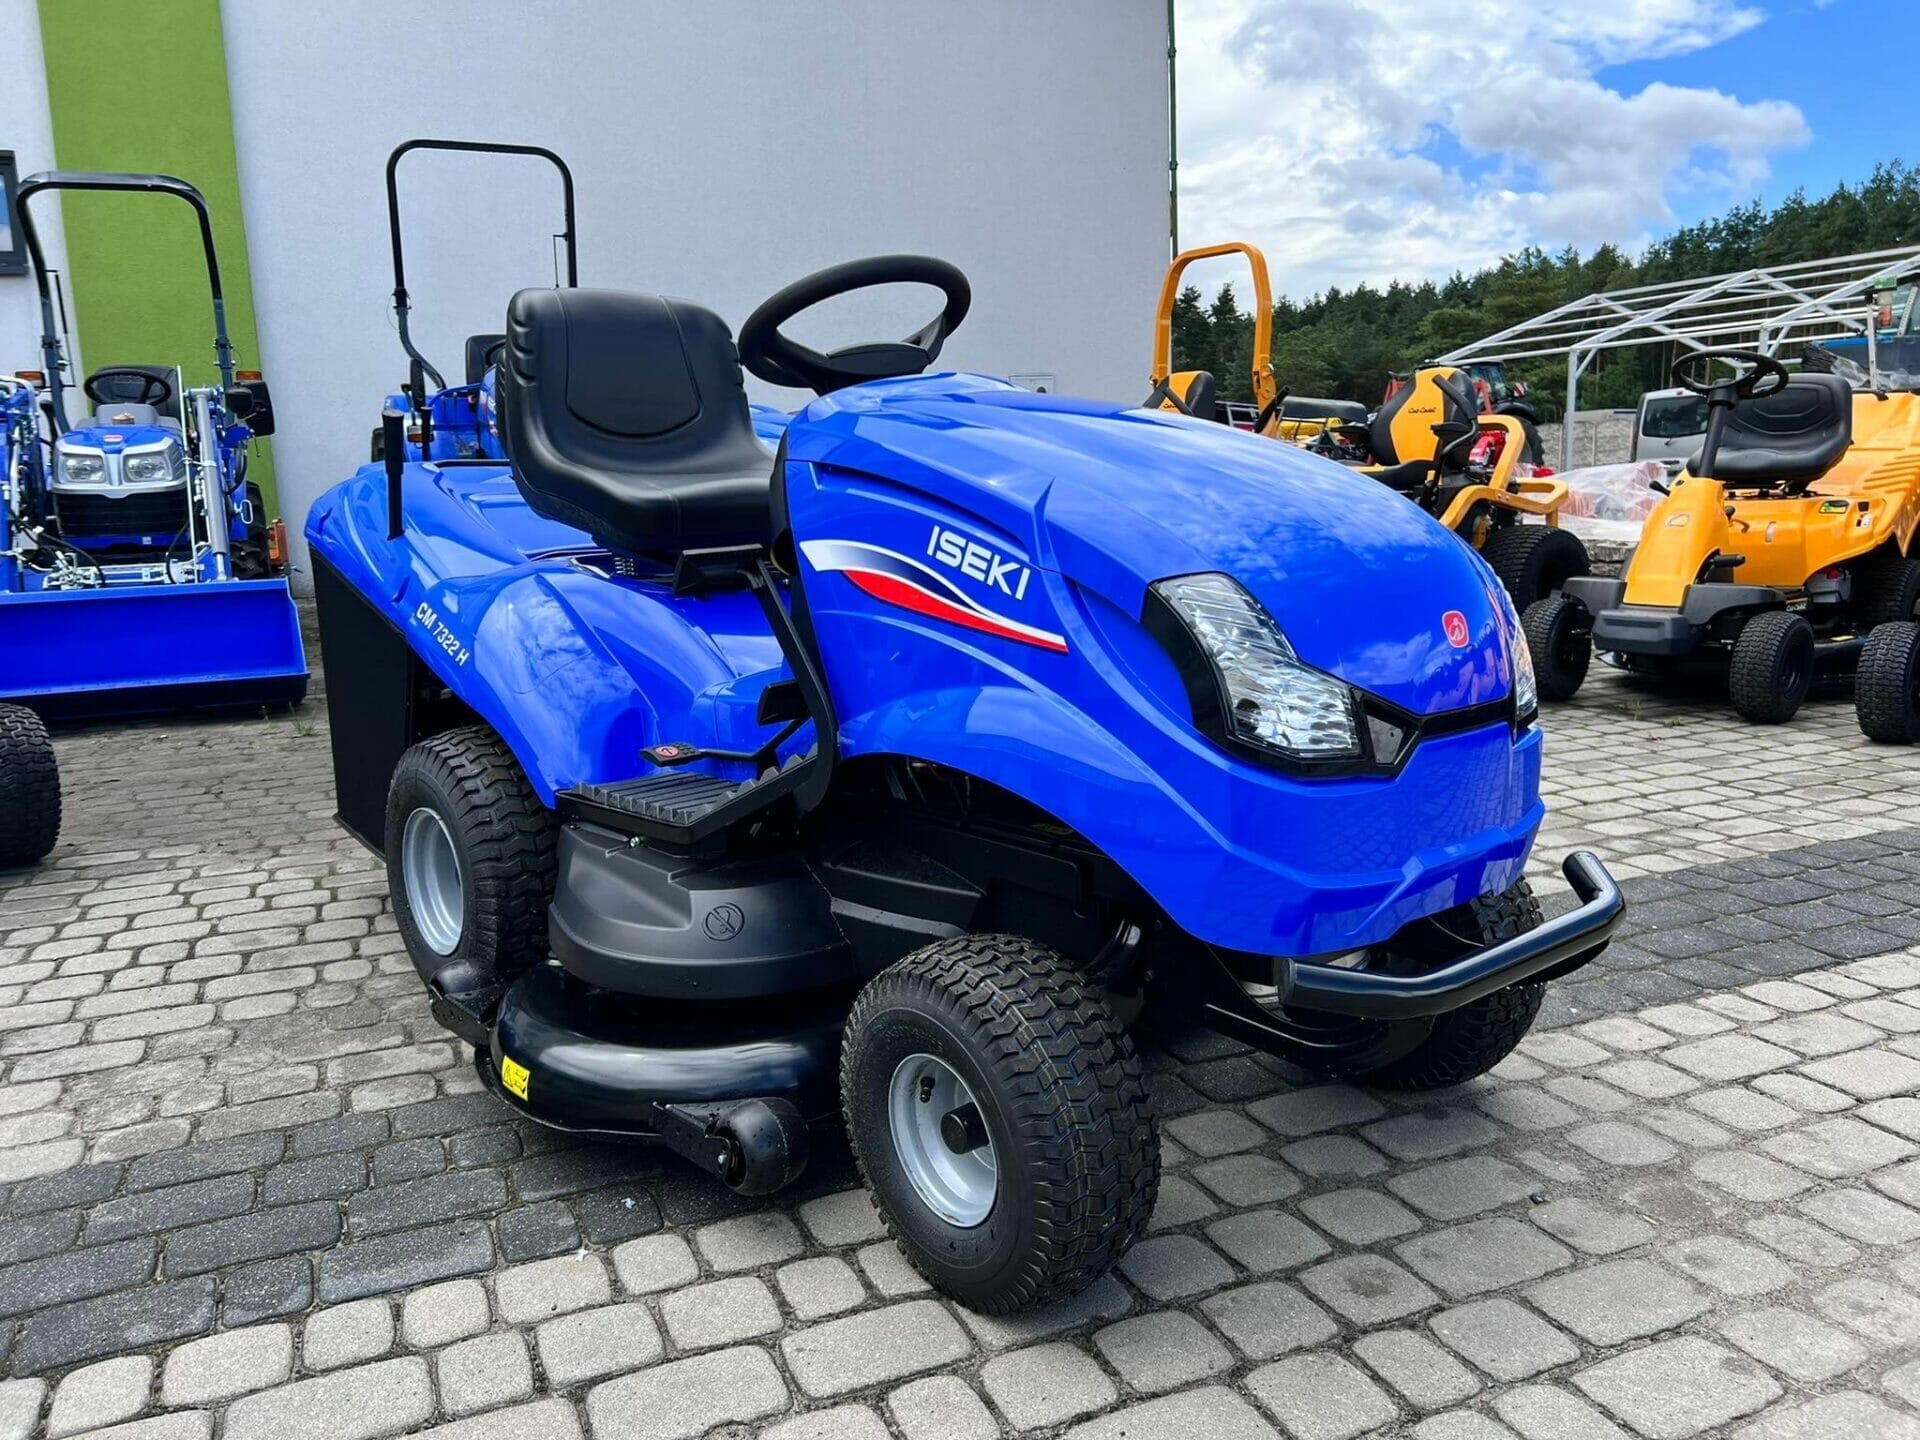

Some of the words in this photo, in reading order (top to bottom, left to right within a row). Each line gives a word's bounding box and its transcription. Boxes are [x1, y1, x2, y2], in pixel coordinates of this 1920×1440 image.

[926, 525, 1031, 601] ISEKI
[416, 602, 438, 630] CM
[432, 621, 460, 657] 7322
[455, 648, 470, 667] H
